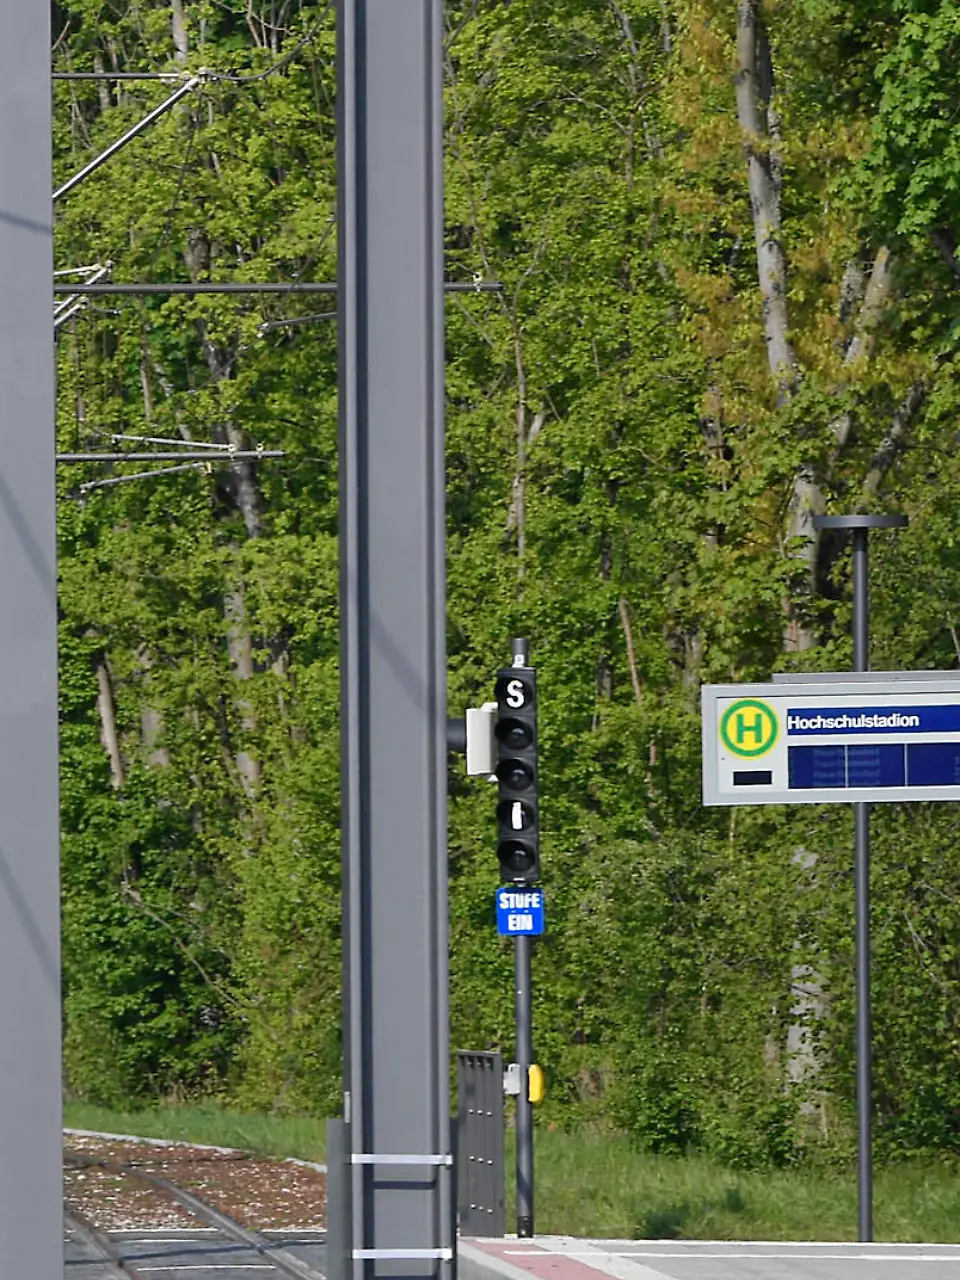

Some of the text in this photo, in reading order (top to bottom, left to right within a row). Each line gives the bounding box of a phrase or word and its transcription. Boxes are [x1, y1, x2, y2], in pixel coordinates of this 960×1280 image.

[736, 713, 763, 744] H
[787, 714, 920, 730] Hochschulstadion
[499, 893, 540, 909] STUFE
[508, 914, 533, 930] EIN
